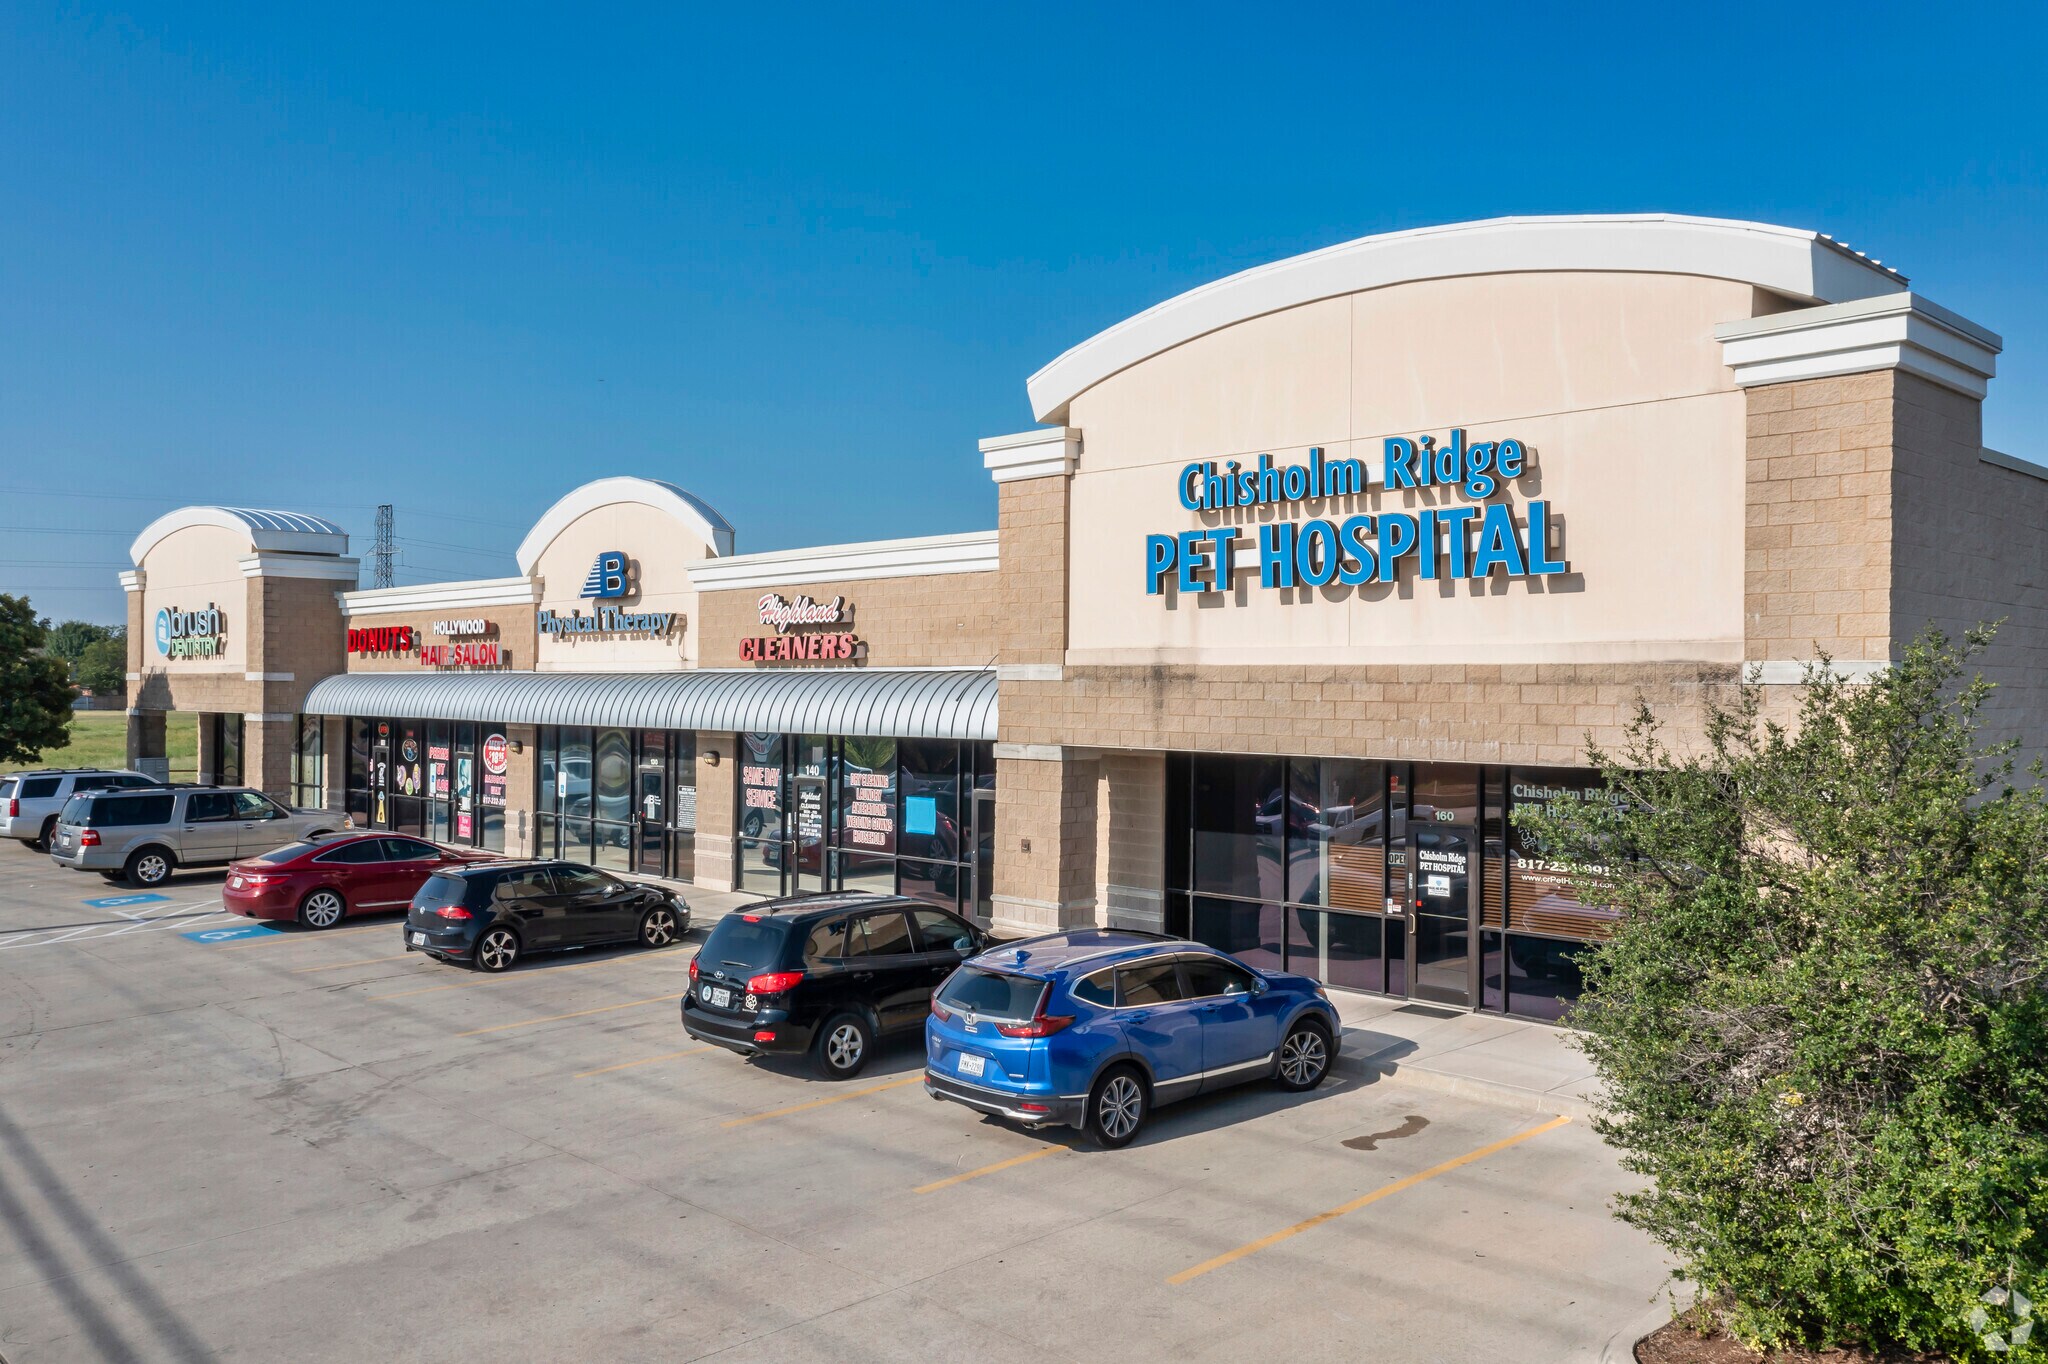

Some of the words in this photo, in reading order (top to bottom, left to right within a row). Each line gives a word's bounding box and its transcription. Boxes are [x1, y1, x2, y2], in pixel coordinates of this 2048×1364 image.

[1178, 447, 1366, 511] Chisholm
[1382, 427, 1528, 499] Ridge
[1145, 527, 1237, 596] PET
[1258, 500, 1568, 590] HOSPITAL
[170, 602, 221, 637] brush
[537, 606, 600, 640] Physical
[601, 605, 676, 636] Therapy
[758, 593, 842, 633] Highland
[433, 619, 485, 635] HOLLYWOOD
[171, 637, 219, 656] DENTISTRY
[347, 625, 412, 653] DONUTS
[738, 634, 855, 662] CLEANERS
[421, 645, 450, 666] HAIR
[454, 643, 498, 666] SALON
[743, 766, 765, 786] SAME
[764, 768, 781, 787] DAY
[805, 765, 820, 777] 140
[861, 774, 889, 789] CLEANING
[745, 788, 776, 809] SERVICE
[855, 788, 882, 802] LAUNDRY
[1512, 784, 1580, 800] Chisholm
[851, 801, 887, 817] ALTERATIONS
[1435, 811, 1454, 821] 160
[845, 814, 872, 830] WEDDING
[871, 817, 893, 833] GOWNS
[852, 829, 886, 846] HOUSEHOLD
[1420, 850, 1447, 861] Chisholm
[1448, 853, 1466, 866] Ridge
[1420, 861, 1432, 871] PET
[1433, 863, 1465, 874] HOSPITAL
